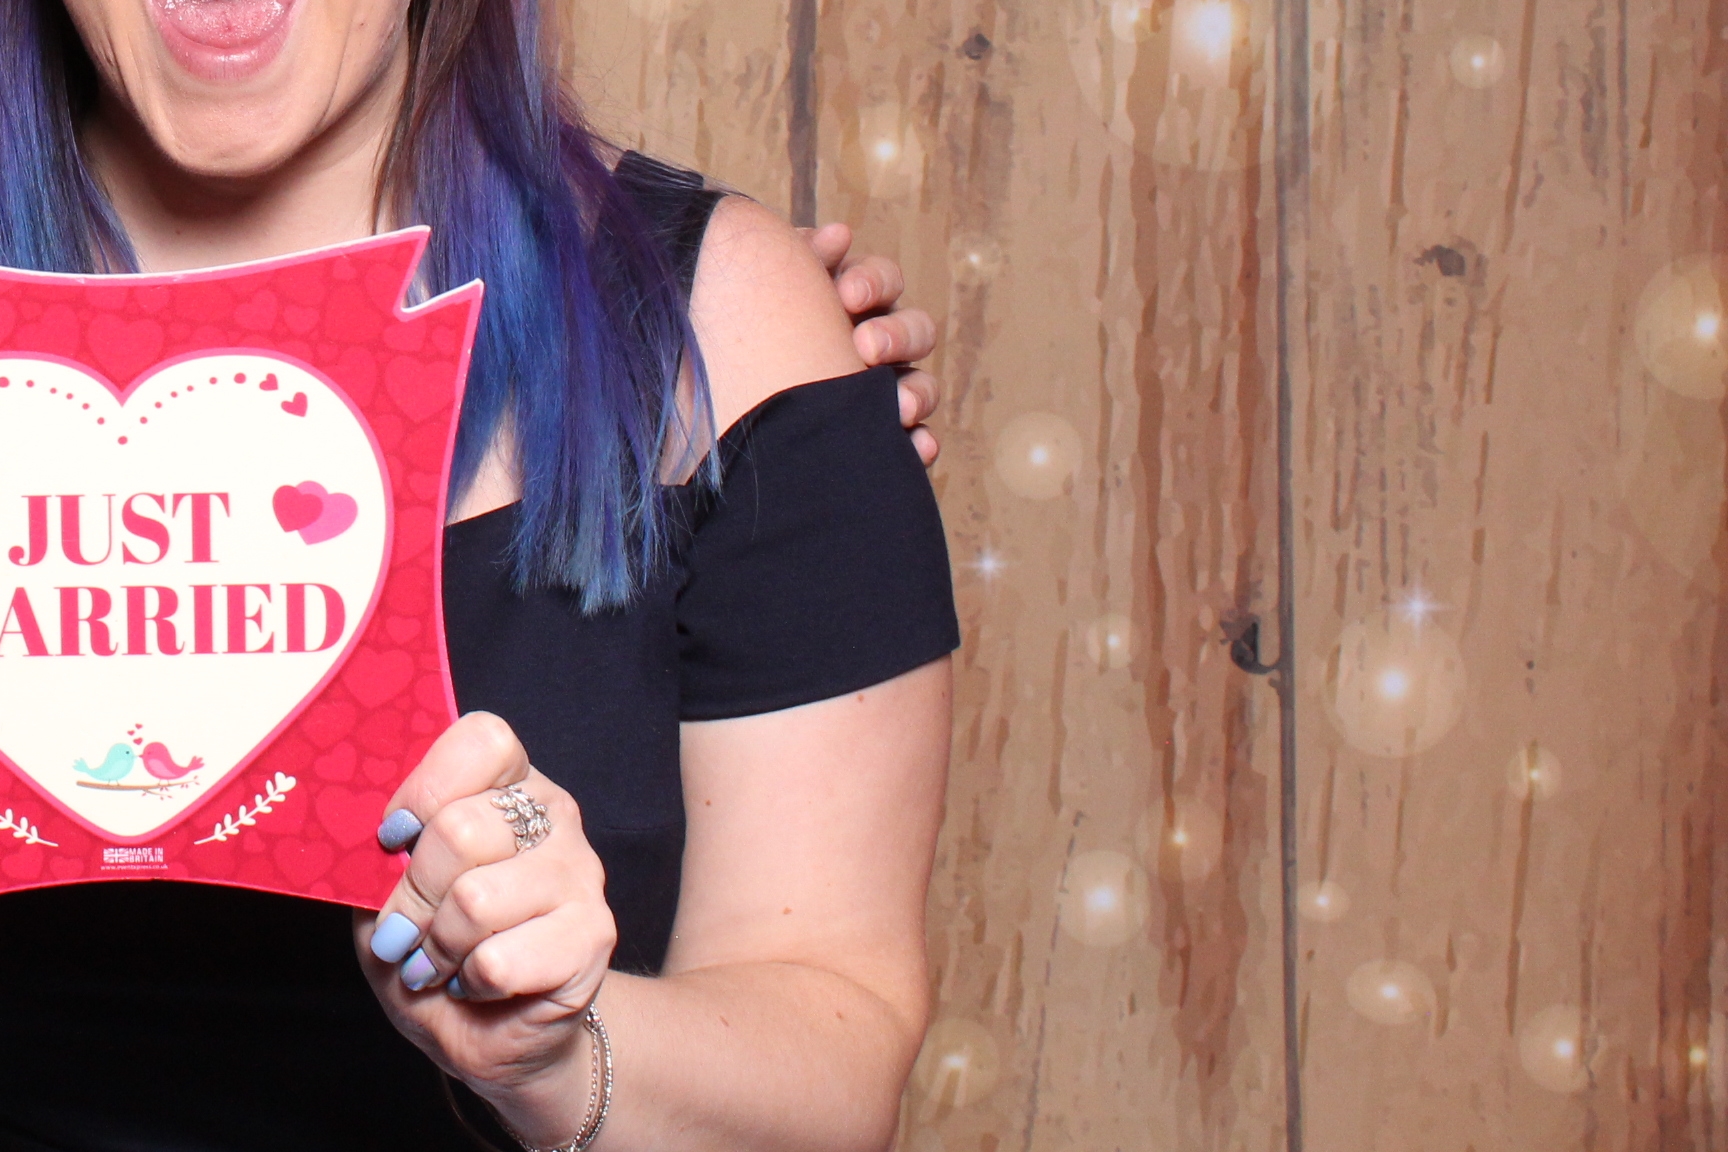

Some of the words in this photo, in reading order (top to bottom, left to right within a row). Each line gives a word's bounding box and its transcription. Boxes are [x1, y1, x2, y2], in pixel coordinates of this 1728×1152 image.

[8, 492, 230, 566] JUST
[129, 847, 153, 855] MADE
[155, 847, 164, 855] IN
[129, 854, 164, 863] BRITAIN
